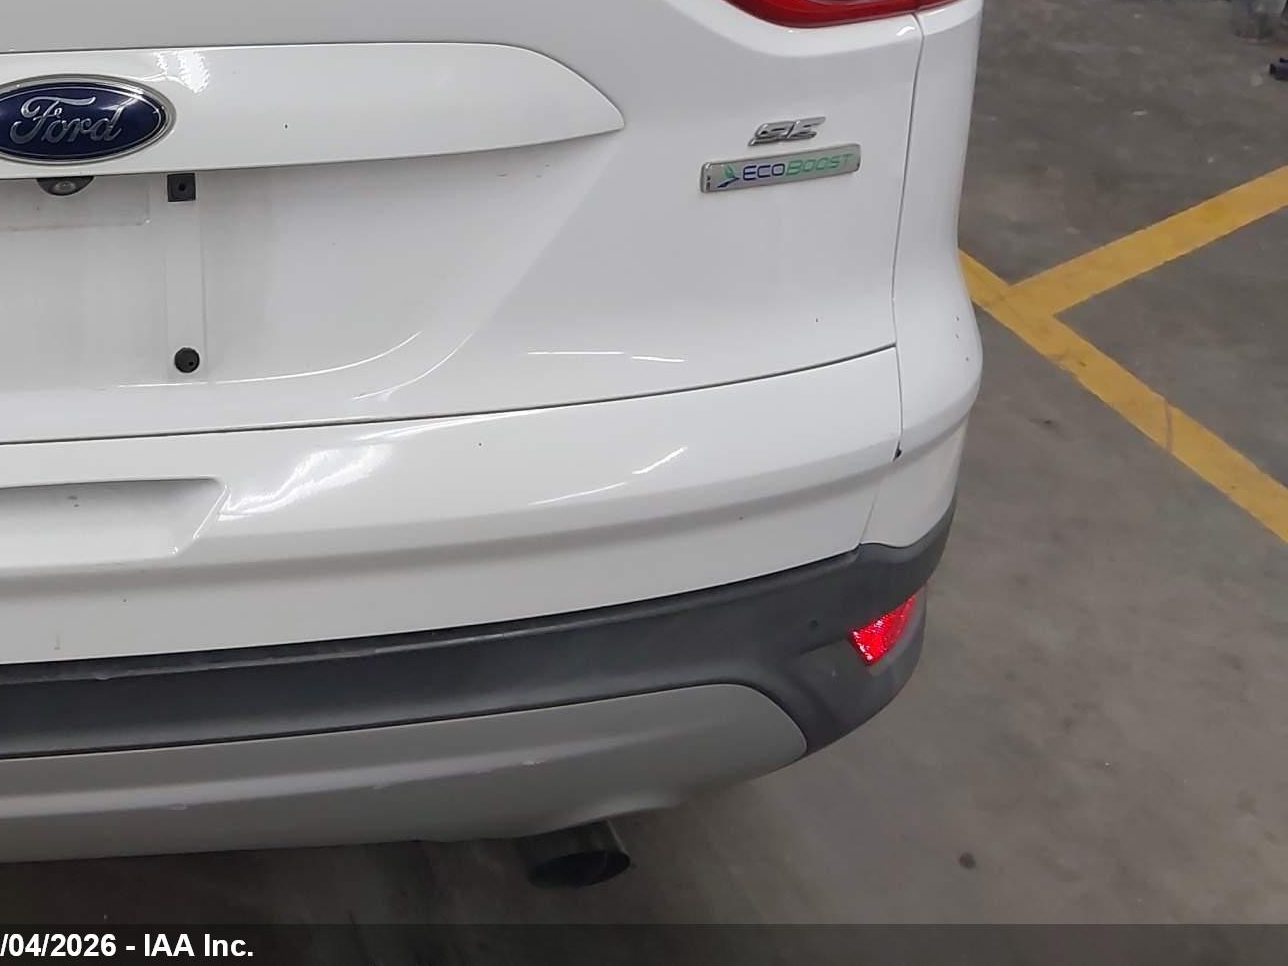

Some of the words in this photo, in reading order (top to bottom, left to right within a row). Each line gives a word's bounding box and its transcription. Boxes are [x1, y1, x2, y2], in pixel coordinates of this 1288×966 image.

[10, 96, 125, 144] Ford
[747, 116, 826, 146] SE
[742, 153, 855, 181] ECOBOOST
